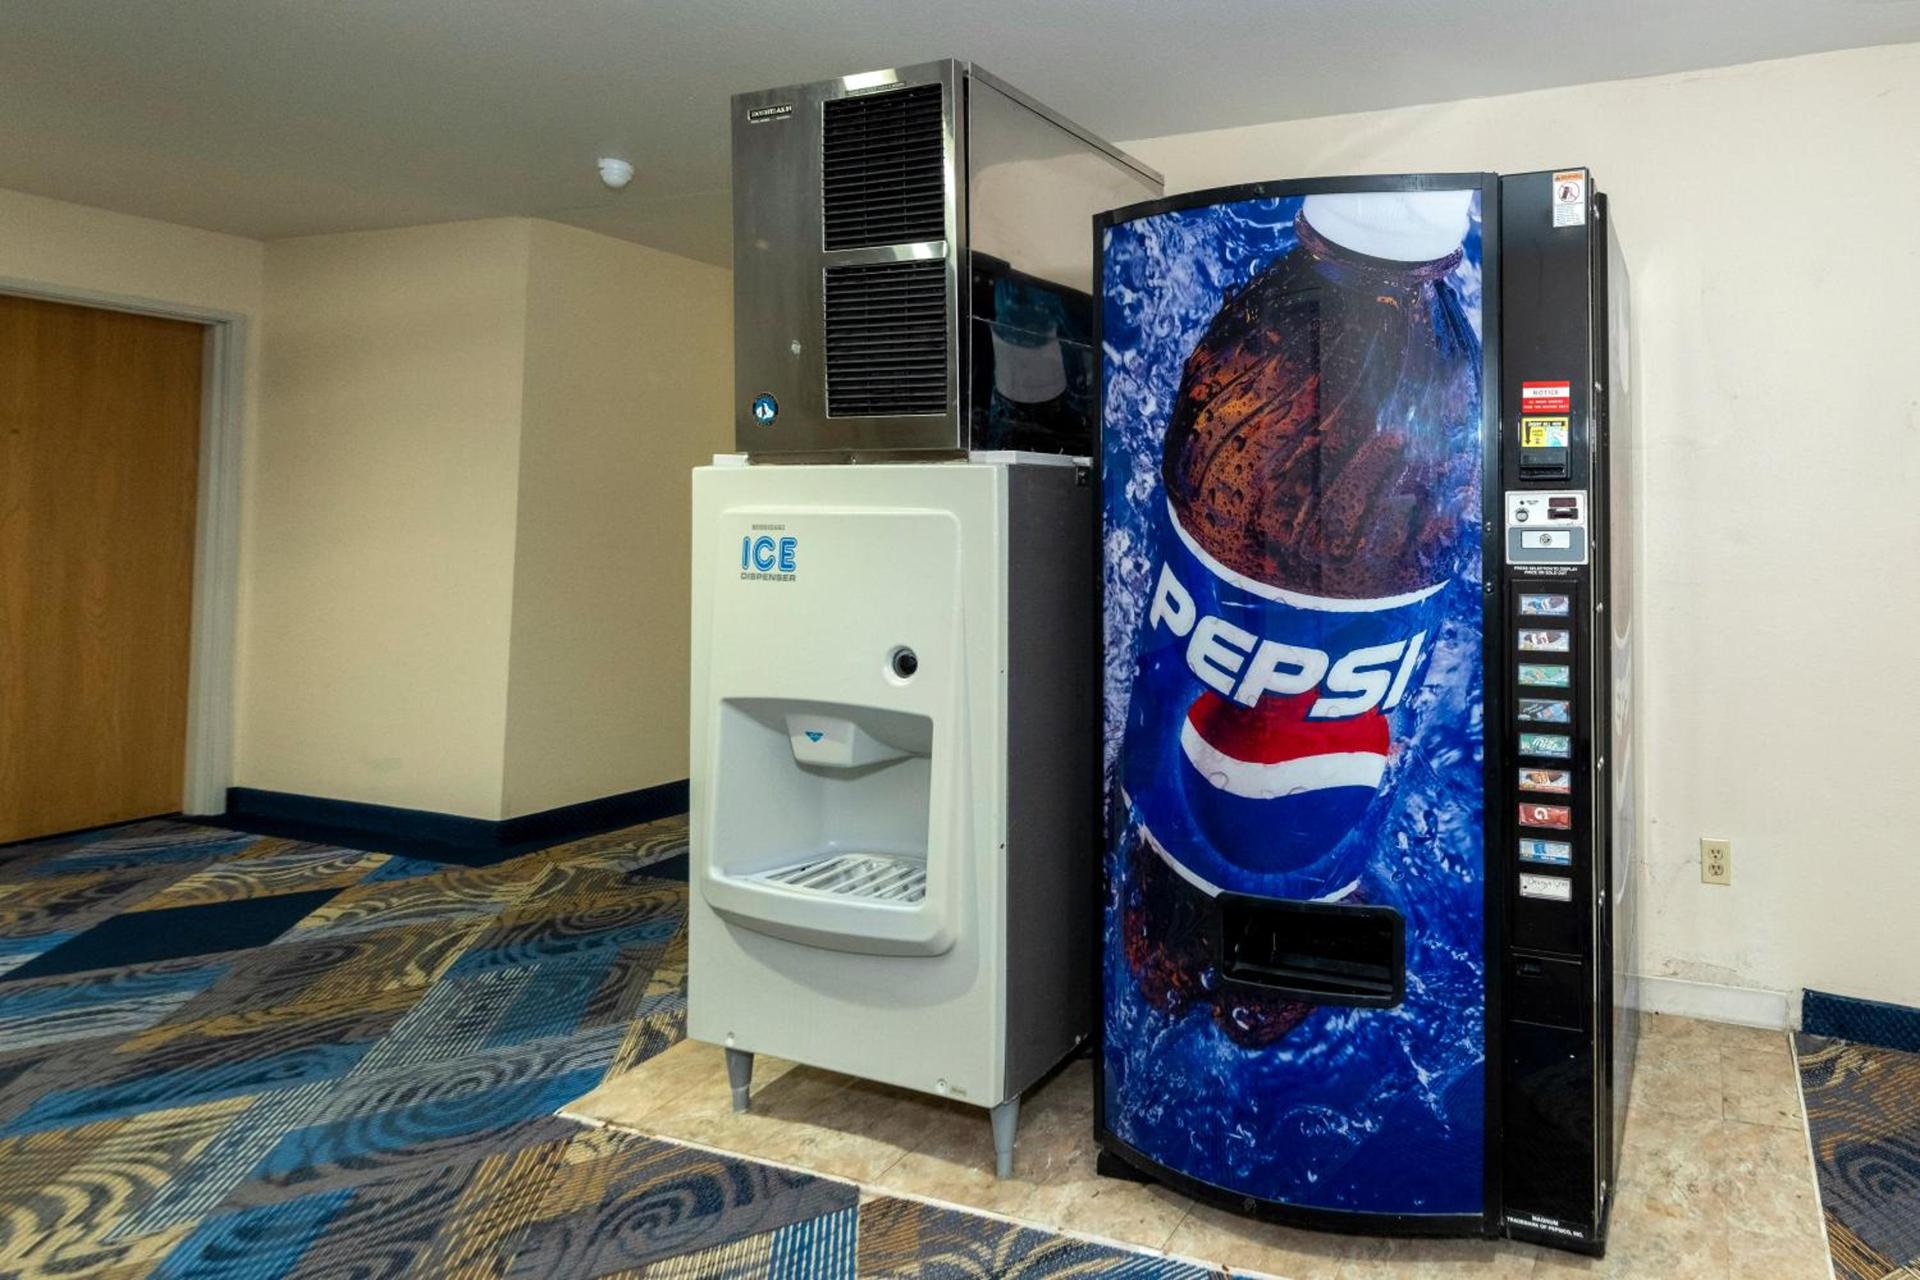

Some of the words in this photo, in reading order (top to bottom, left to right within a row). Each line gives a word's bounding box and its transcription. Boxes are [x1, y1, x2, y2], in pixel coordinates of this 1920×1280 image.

[742, 536, 798, 572] ICE
[740, 572, 797, 582] DISPENSER
[1151, 561, 1427, 717] PEPSI
[1506, 1216, 1539, 1228] TRADEMARK
